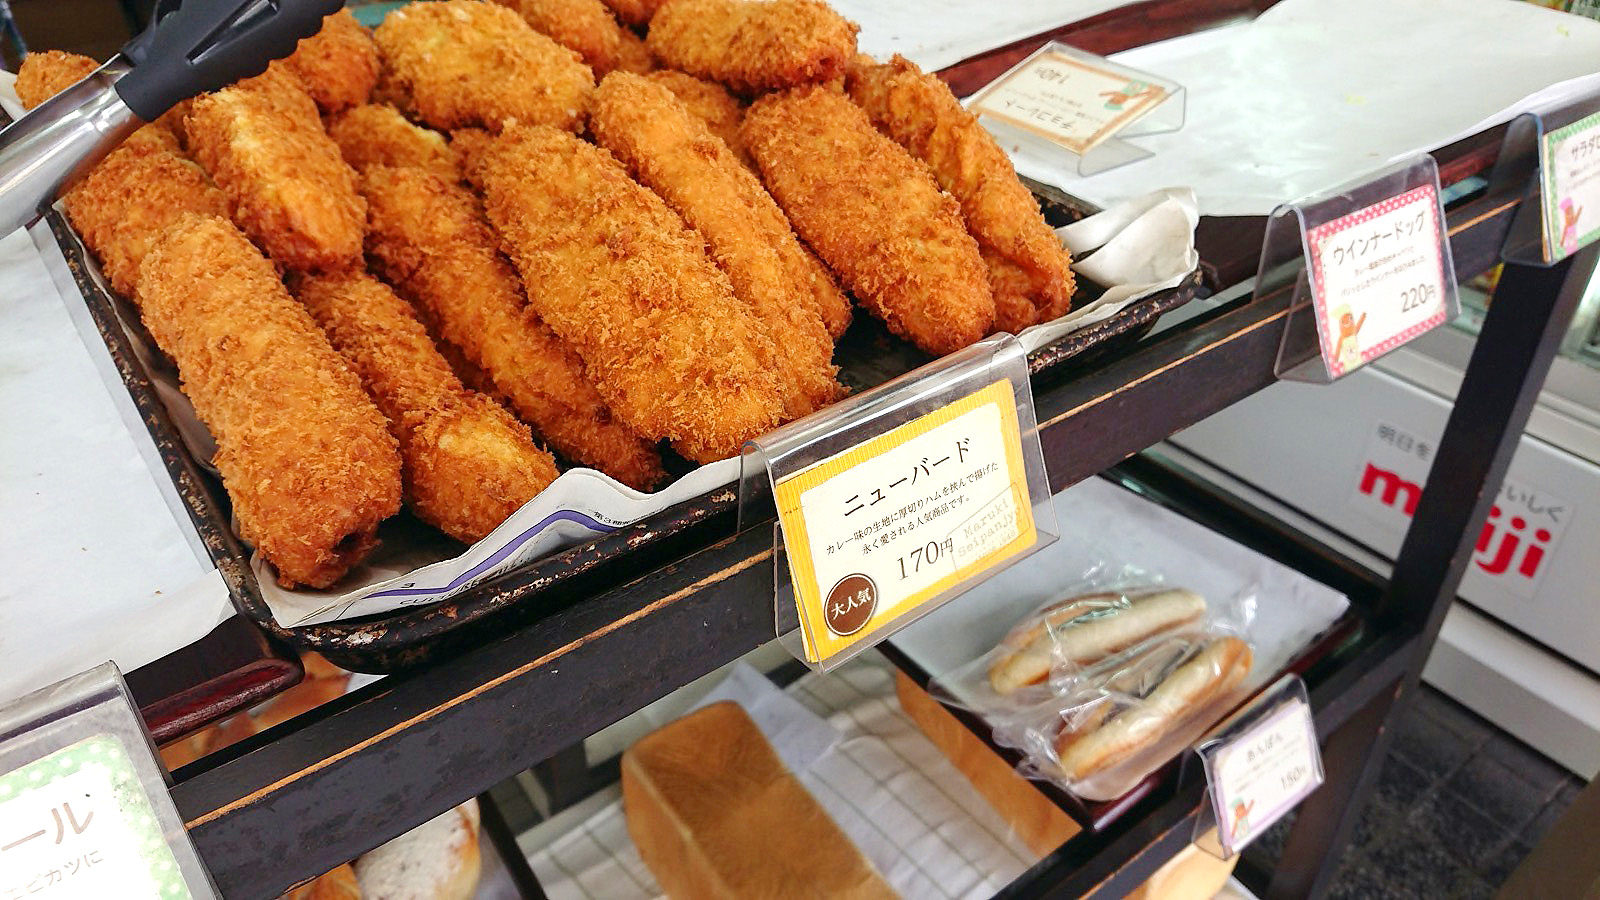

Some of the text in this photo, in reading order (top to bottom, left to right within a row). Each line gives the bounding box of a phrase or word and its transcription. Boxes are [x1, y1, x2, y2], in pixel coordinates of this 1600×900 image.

[1333, 211, 1426, 266] ウインナードッグ
[1401, 283, 1436, 313] 220円
[844, 437, 970, 517] ニューバード
[826, 461, 999, 555] カレー味の生地に厚切りハムを挟んで揚げた
[862, 498, 970, 556] 永く愛される人気商品です。
[963, 499, 1010, 540] Maruki
[1359, 462, 1552, 579] miji
[897, 537, 954, 581] 170円
[831, 587, 872, 620] 大人気
